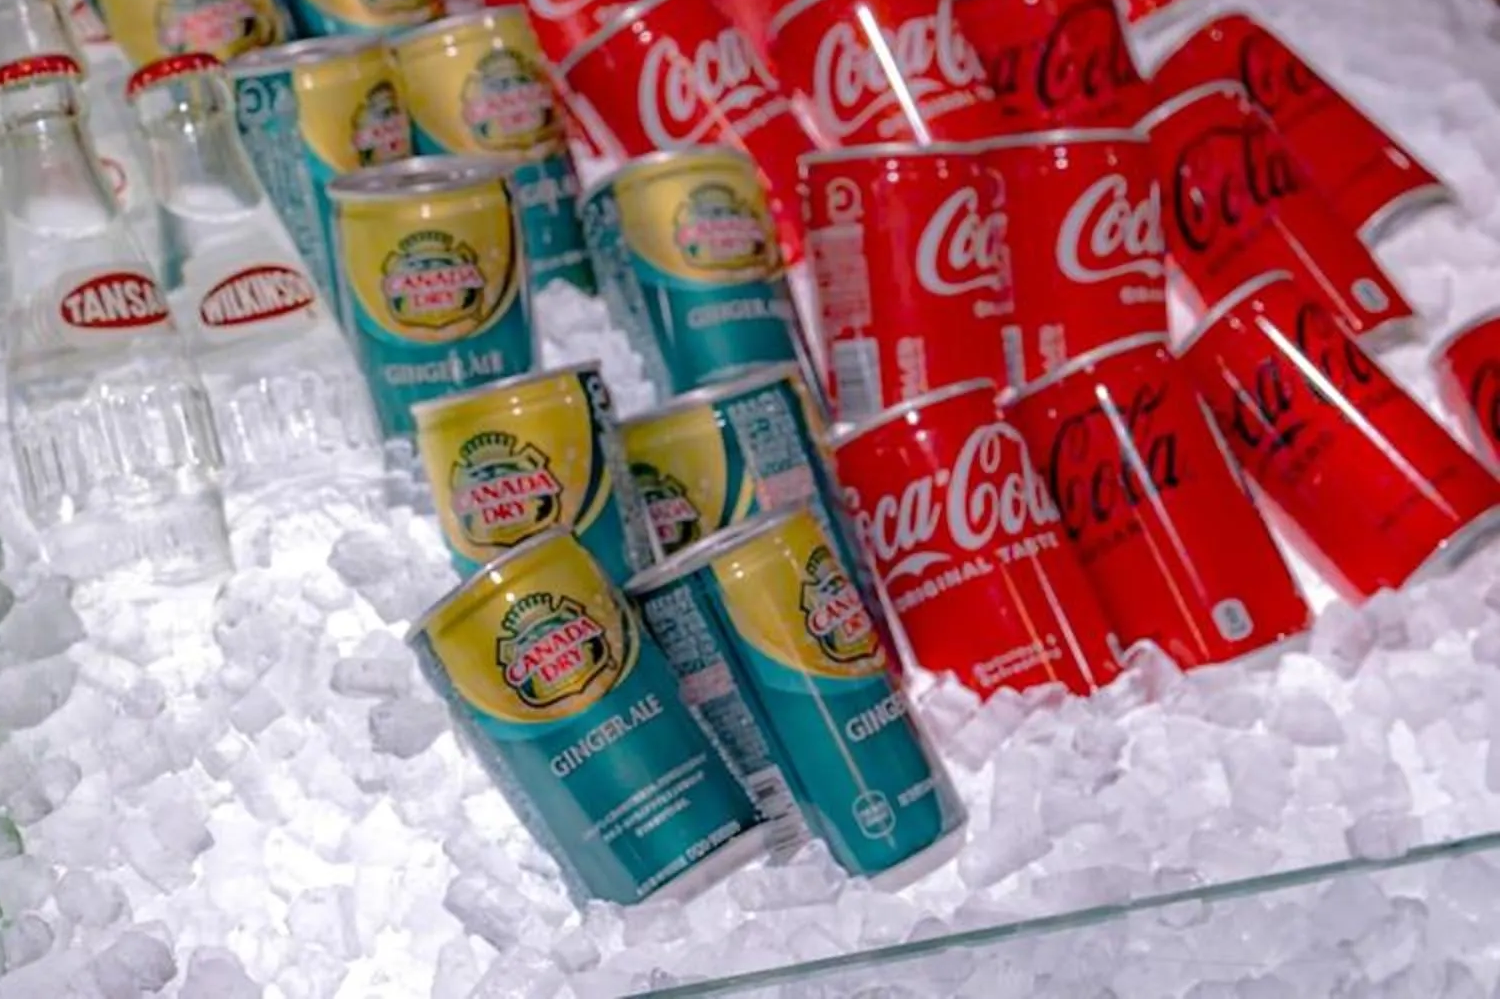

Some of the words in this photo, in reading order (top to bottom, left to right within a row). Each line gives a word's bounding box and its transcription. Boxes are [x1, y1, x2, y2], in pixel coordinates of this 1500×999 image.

[508, 616, 601, 685] CANADA
[539, 646, 584, 684] DRY
[550, 717, 631, 779] GINGER
[628, 693, 664, 730] ALE
